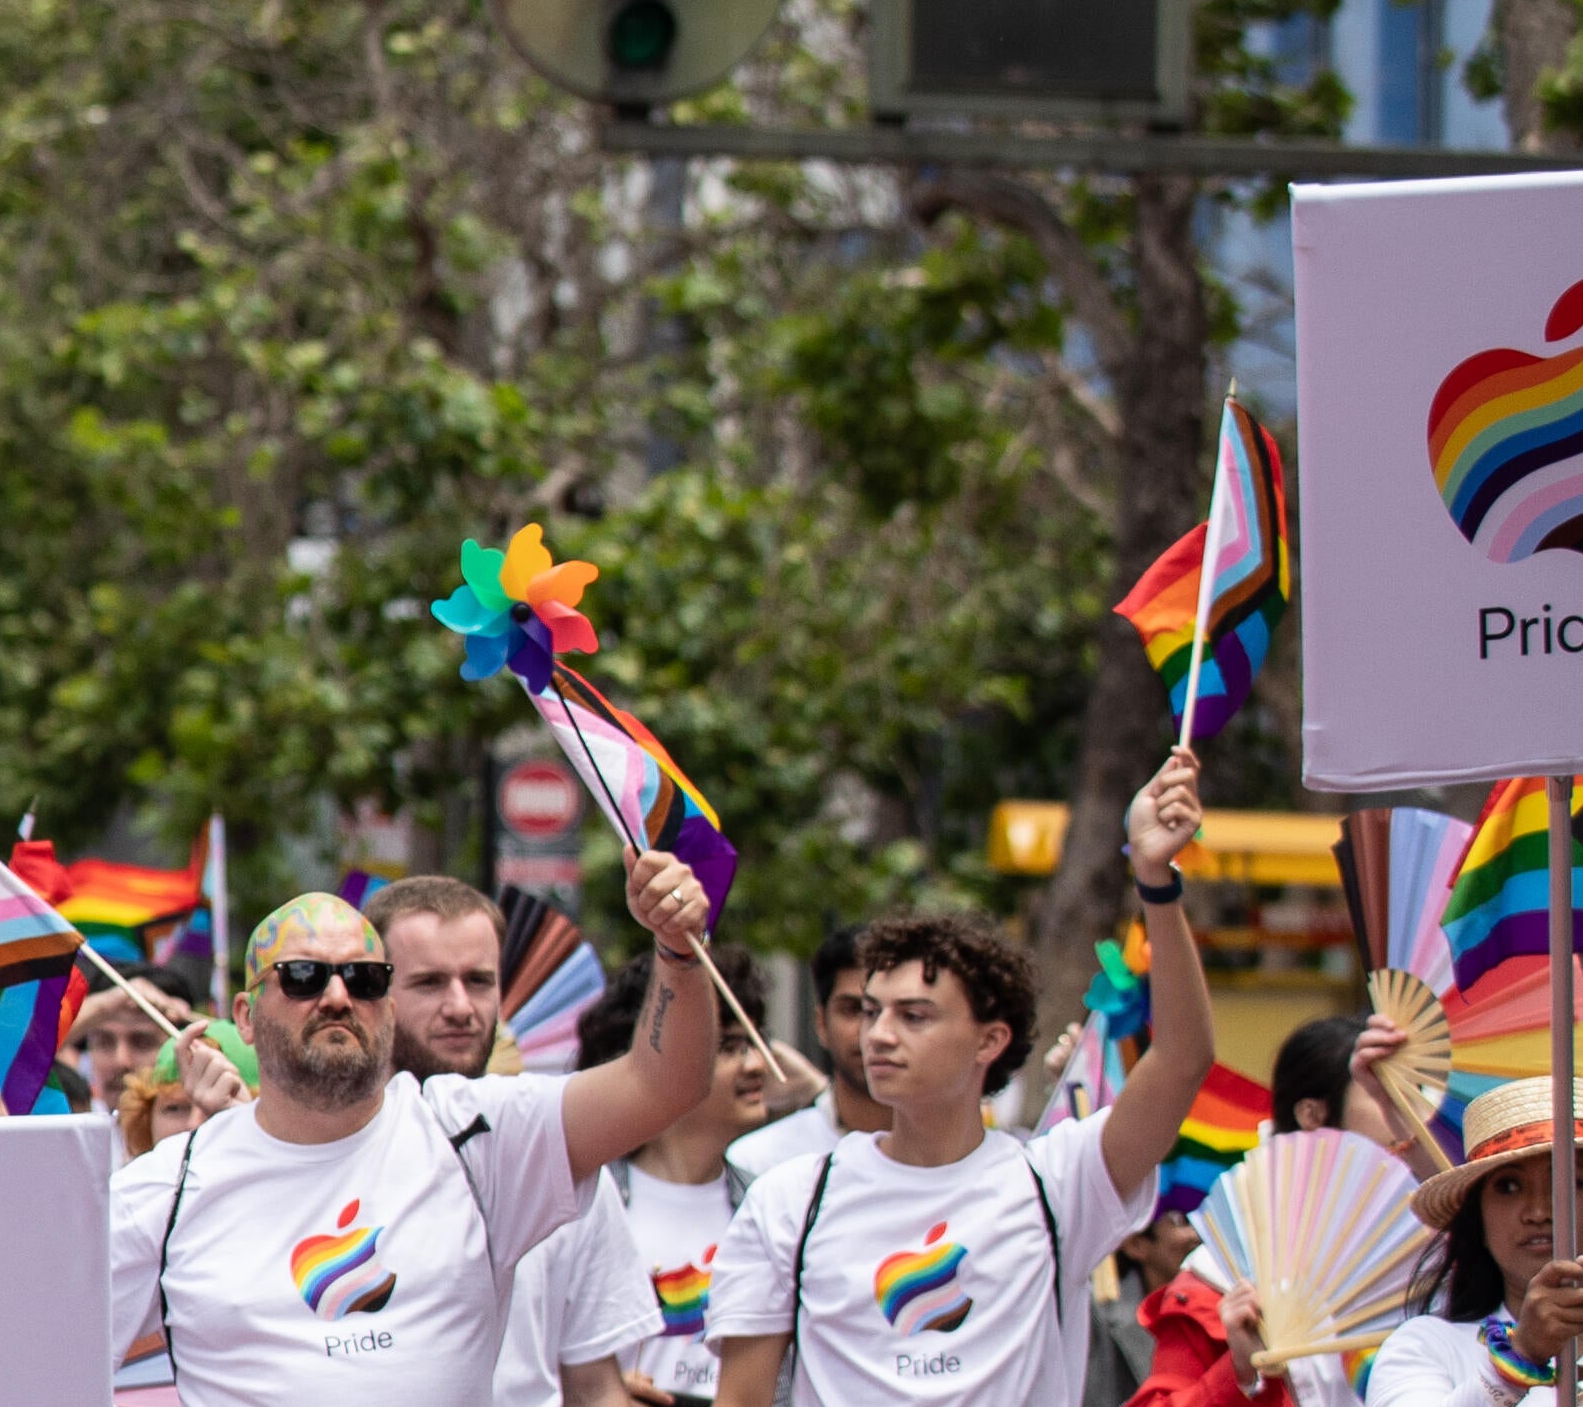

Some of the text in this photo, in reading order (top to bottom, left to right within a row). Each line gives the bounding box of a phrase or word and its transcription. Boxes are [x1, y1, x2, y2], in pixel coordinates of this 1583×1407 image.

[1479, 603, 1583, 660] Prid
[325, 1329, 393, 1357] Pride
[896, 1352, 961, 1375] Pride
